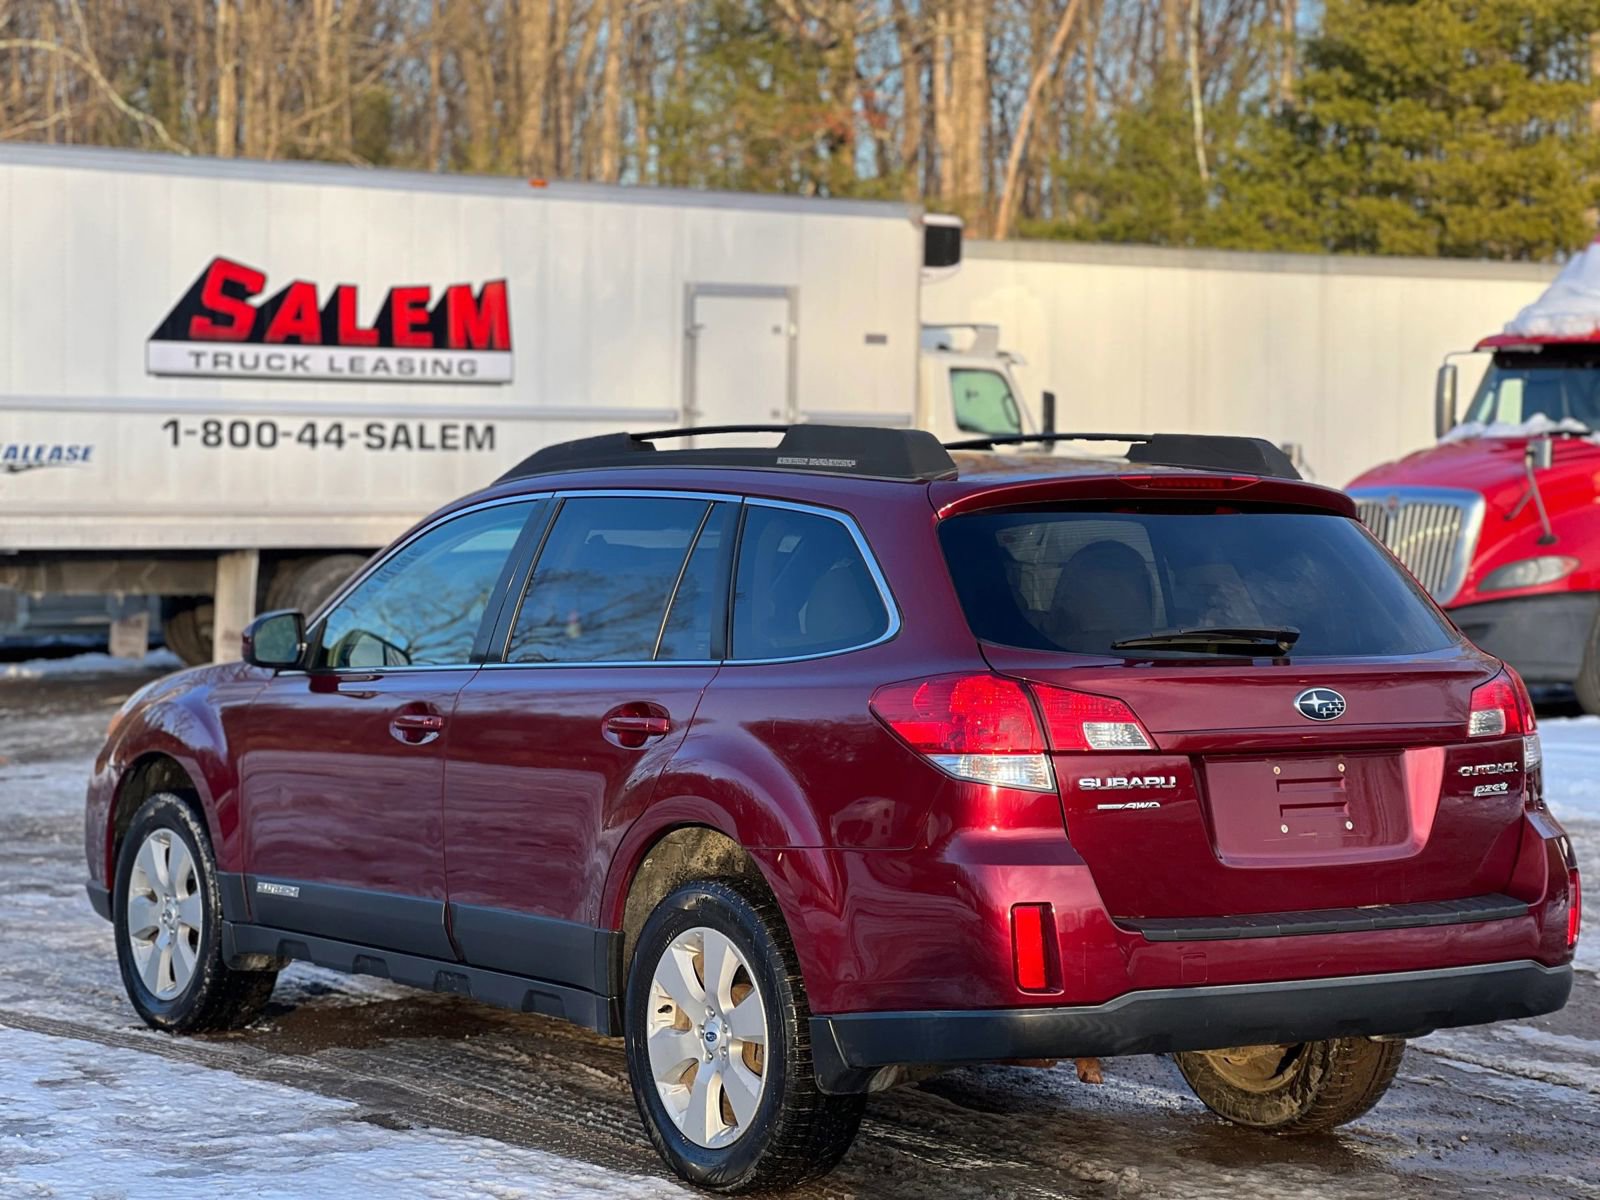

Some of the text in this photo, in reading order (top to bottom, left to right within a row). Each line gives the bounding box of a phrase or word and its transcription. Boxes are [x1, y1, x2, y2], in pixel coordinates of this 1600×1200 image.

[187, 254, 512, 350] SALEM
[187, 350, 479, 378] TRUCK LEASING
[162, 417, 496, 451] 1-800-44-SALEM
[1078, 776, 1176, 790] SUBARU
